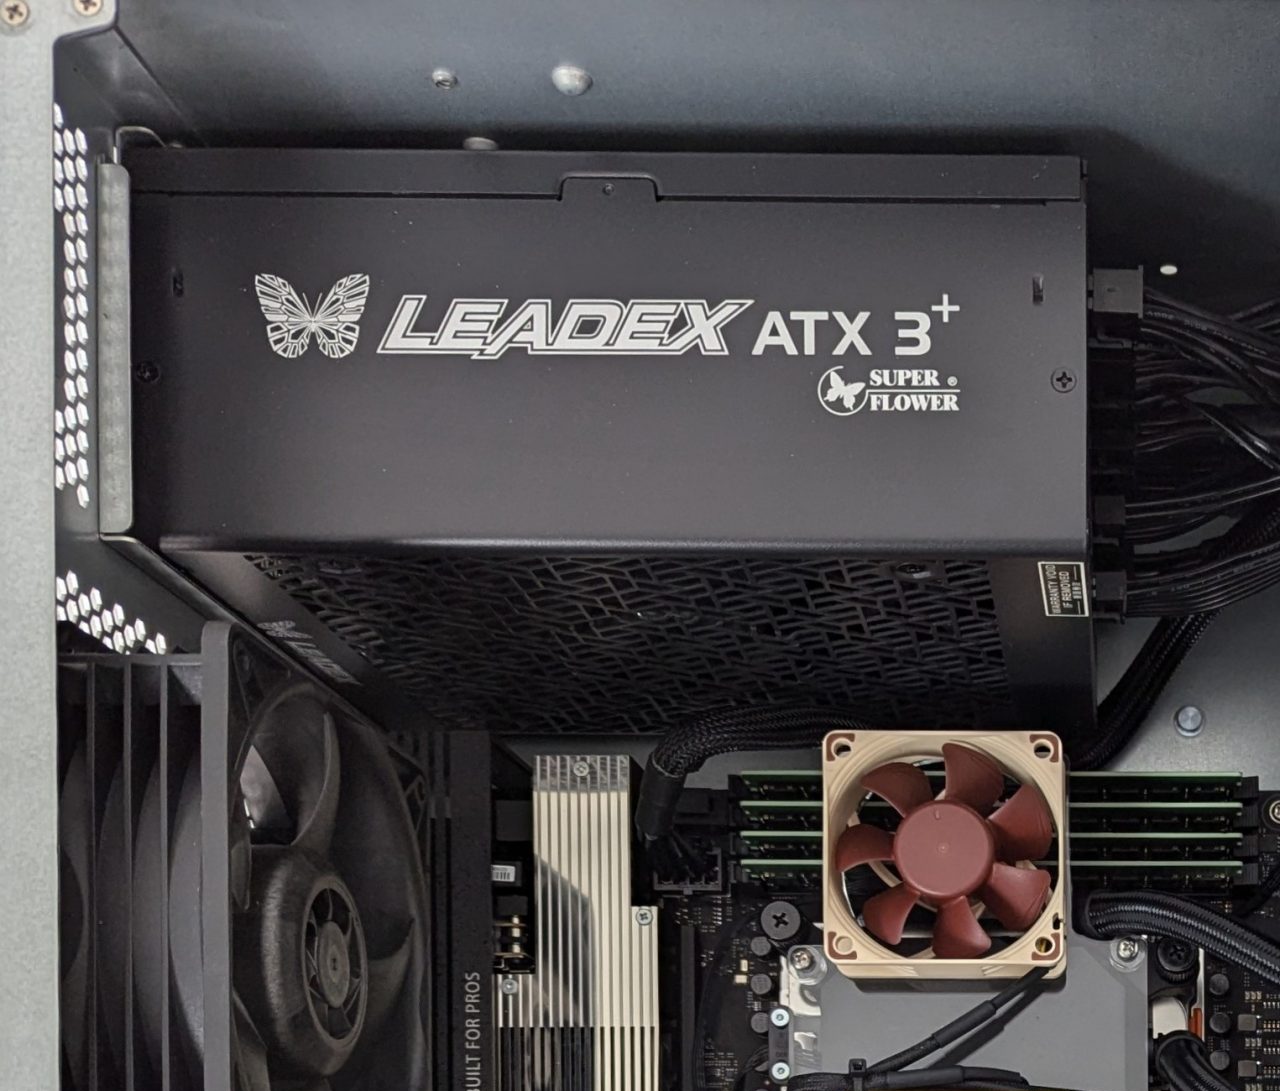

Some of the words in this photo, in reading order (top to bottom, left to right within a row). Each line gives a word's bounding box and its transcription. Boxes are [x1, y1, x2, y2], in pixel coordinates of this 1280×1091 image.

[376, 294, 755, 359] LEADEX
[751, 311, 873, 356] ATX
[869, 368, 941, 387] SUPER
[869, 394, 960, 412] FLOWER
[1045, 564, 1057, 580] VOID
[1059, 571, 1072, 601] REMOVED
[1047, 581, 1061, 613] WARRANTY
[464, 971, 480, 1013] PROS
[465, 1018, 481, 1049] FOR
